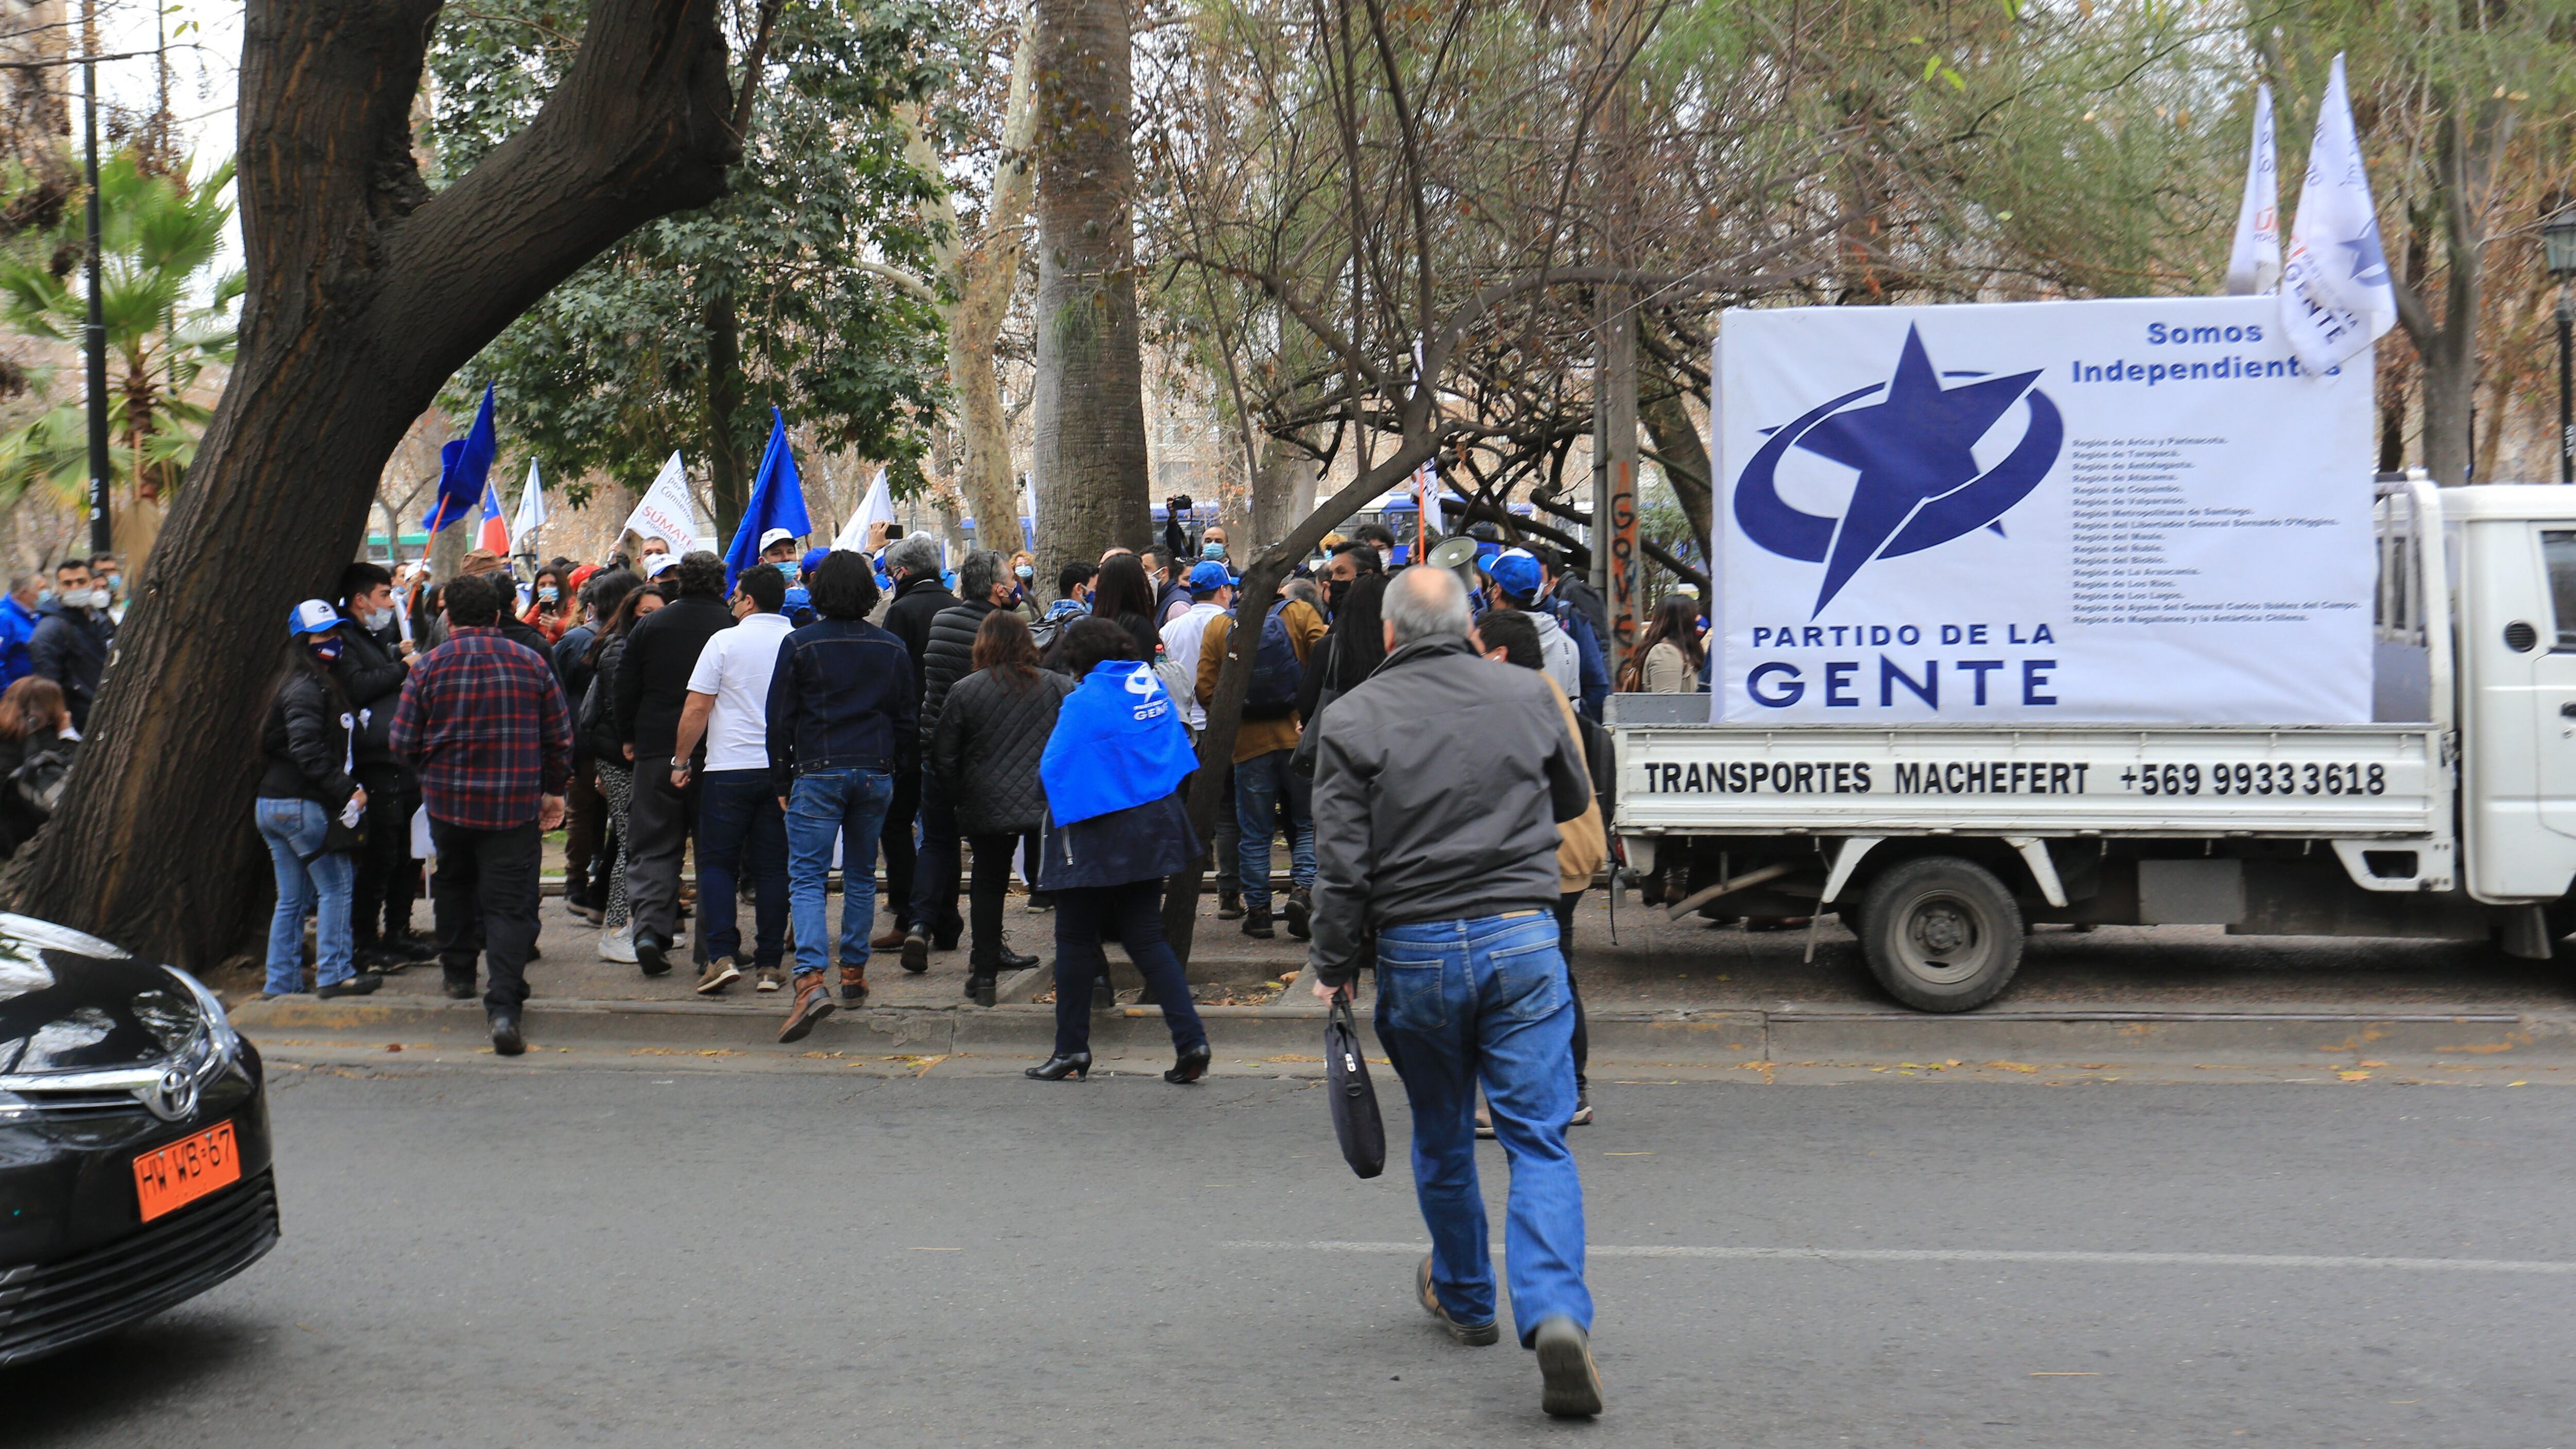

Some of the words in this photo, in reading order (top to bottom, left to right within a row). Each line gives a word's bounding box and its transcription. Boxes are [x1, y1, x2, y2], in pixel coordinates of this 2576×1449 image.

[2147, 322, 2263, 345] Somos
[2072, 353, 2342, 386] Independients
[2111, 486, 2125, 494] de
[2111, 580, 2125, 588] de
[2112, 568, 2125, 577] de
[2111, 592, 2126, 600] de
[1753, 625, 1921, 648] PARTIDO
[1941, 624, 1988, 646] DE
[2008, 623, 2056, 645] LA
[1747, 653, 2058, 712] GENTE
[1645, 762, 1871, 794] TRANSPORTES
[1895, 762, 2089, 794] MACHEFERT
[2121, 763, 2200, 796] +569
